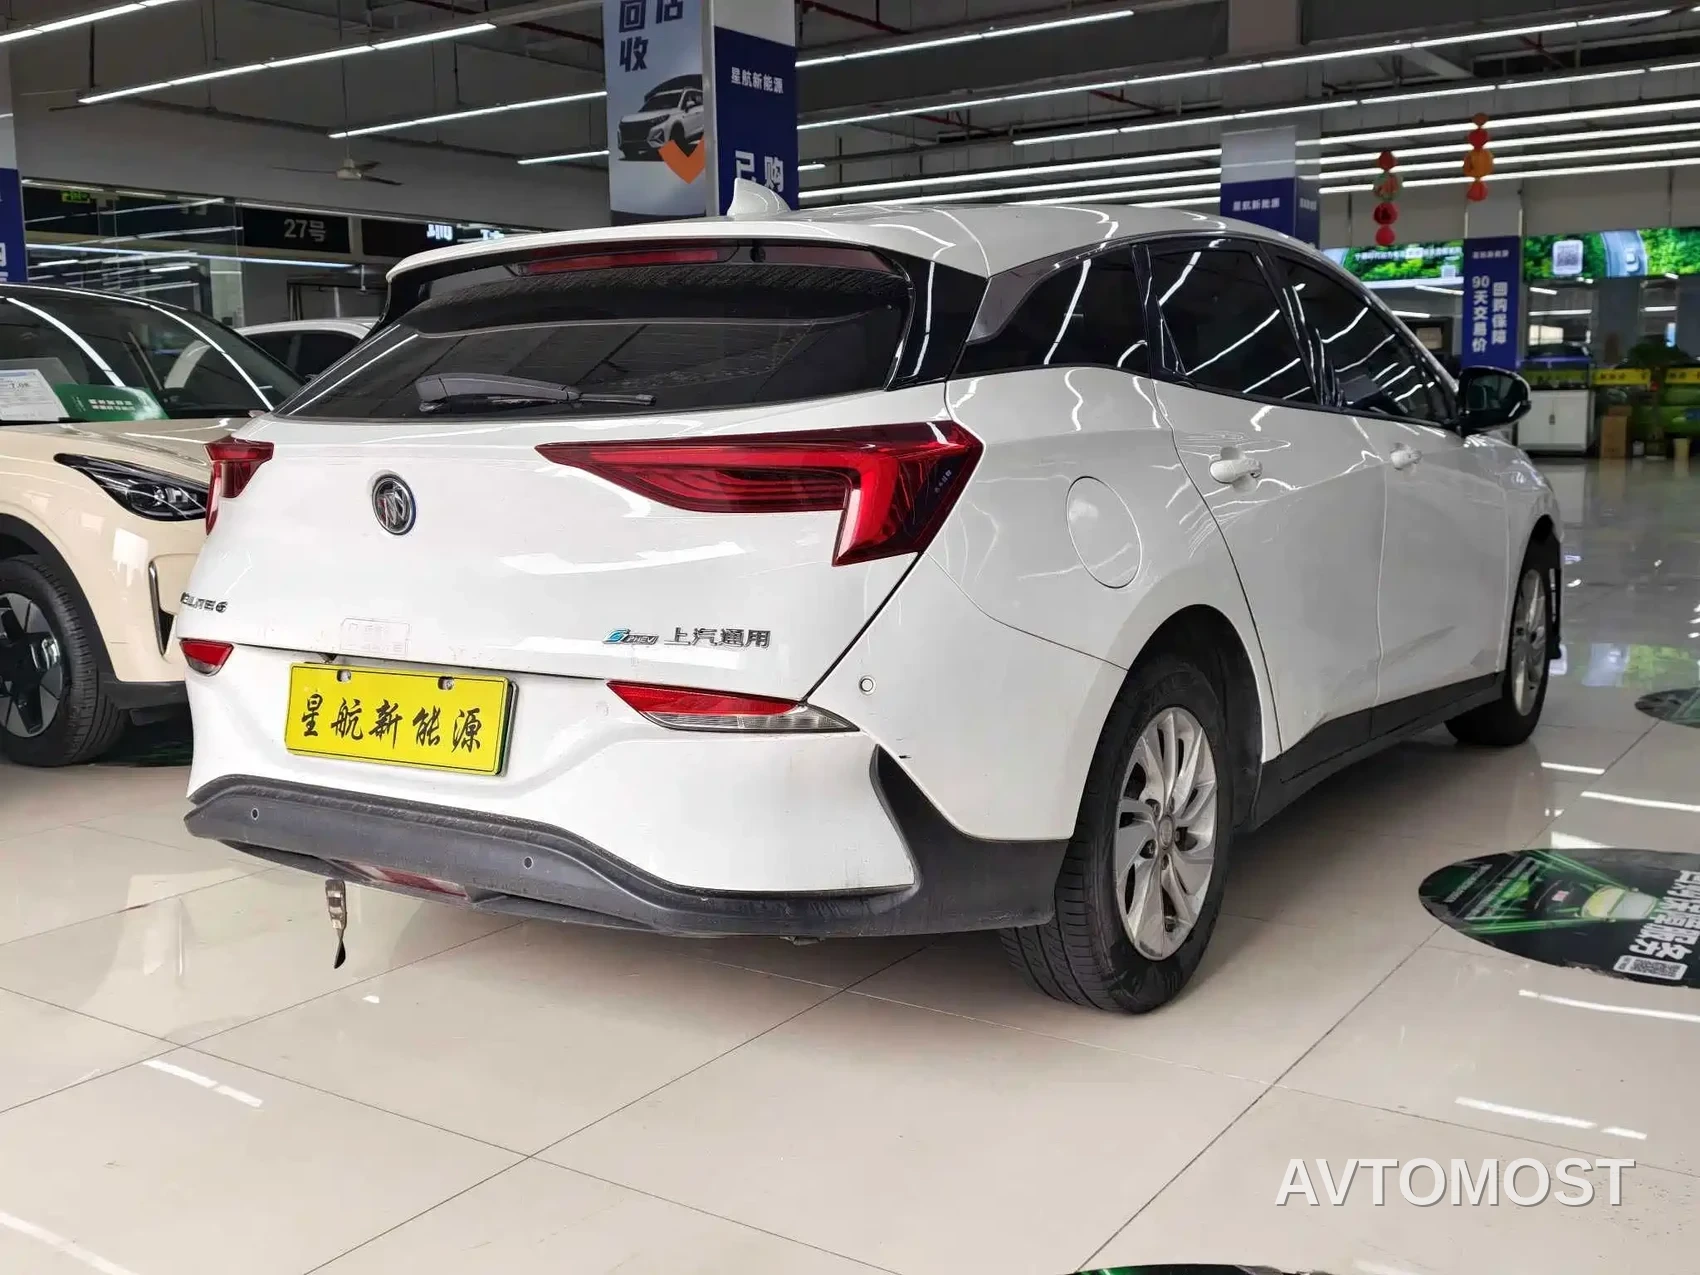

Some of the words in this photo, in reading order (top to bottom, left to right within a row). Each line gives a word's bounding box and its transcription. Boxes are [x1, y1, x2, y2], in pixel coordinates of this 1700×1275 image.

[619, 0, 648, 72] 回收
[730, 66, 784, 94] 星航新能源
[283, 218, 326, 242] 27号
[663, 626, 771, 649] 上汽通用
[301, 691, 482, 753] 星航新能源
